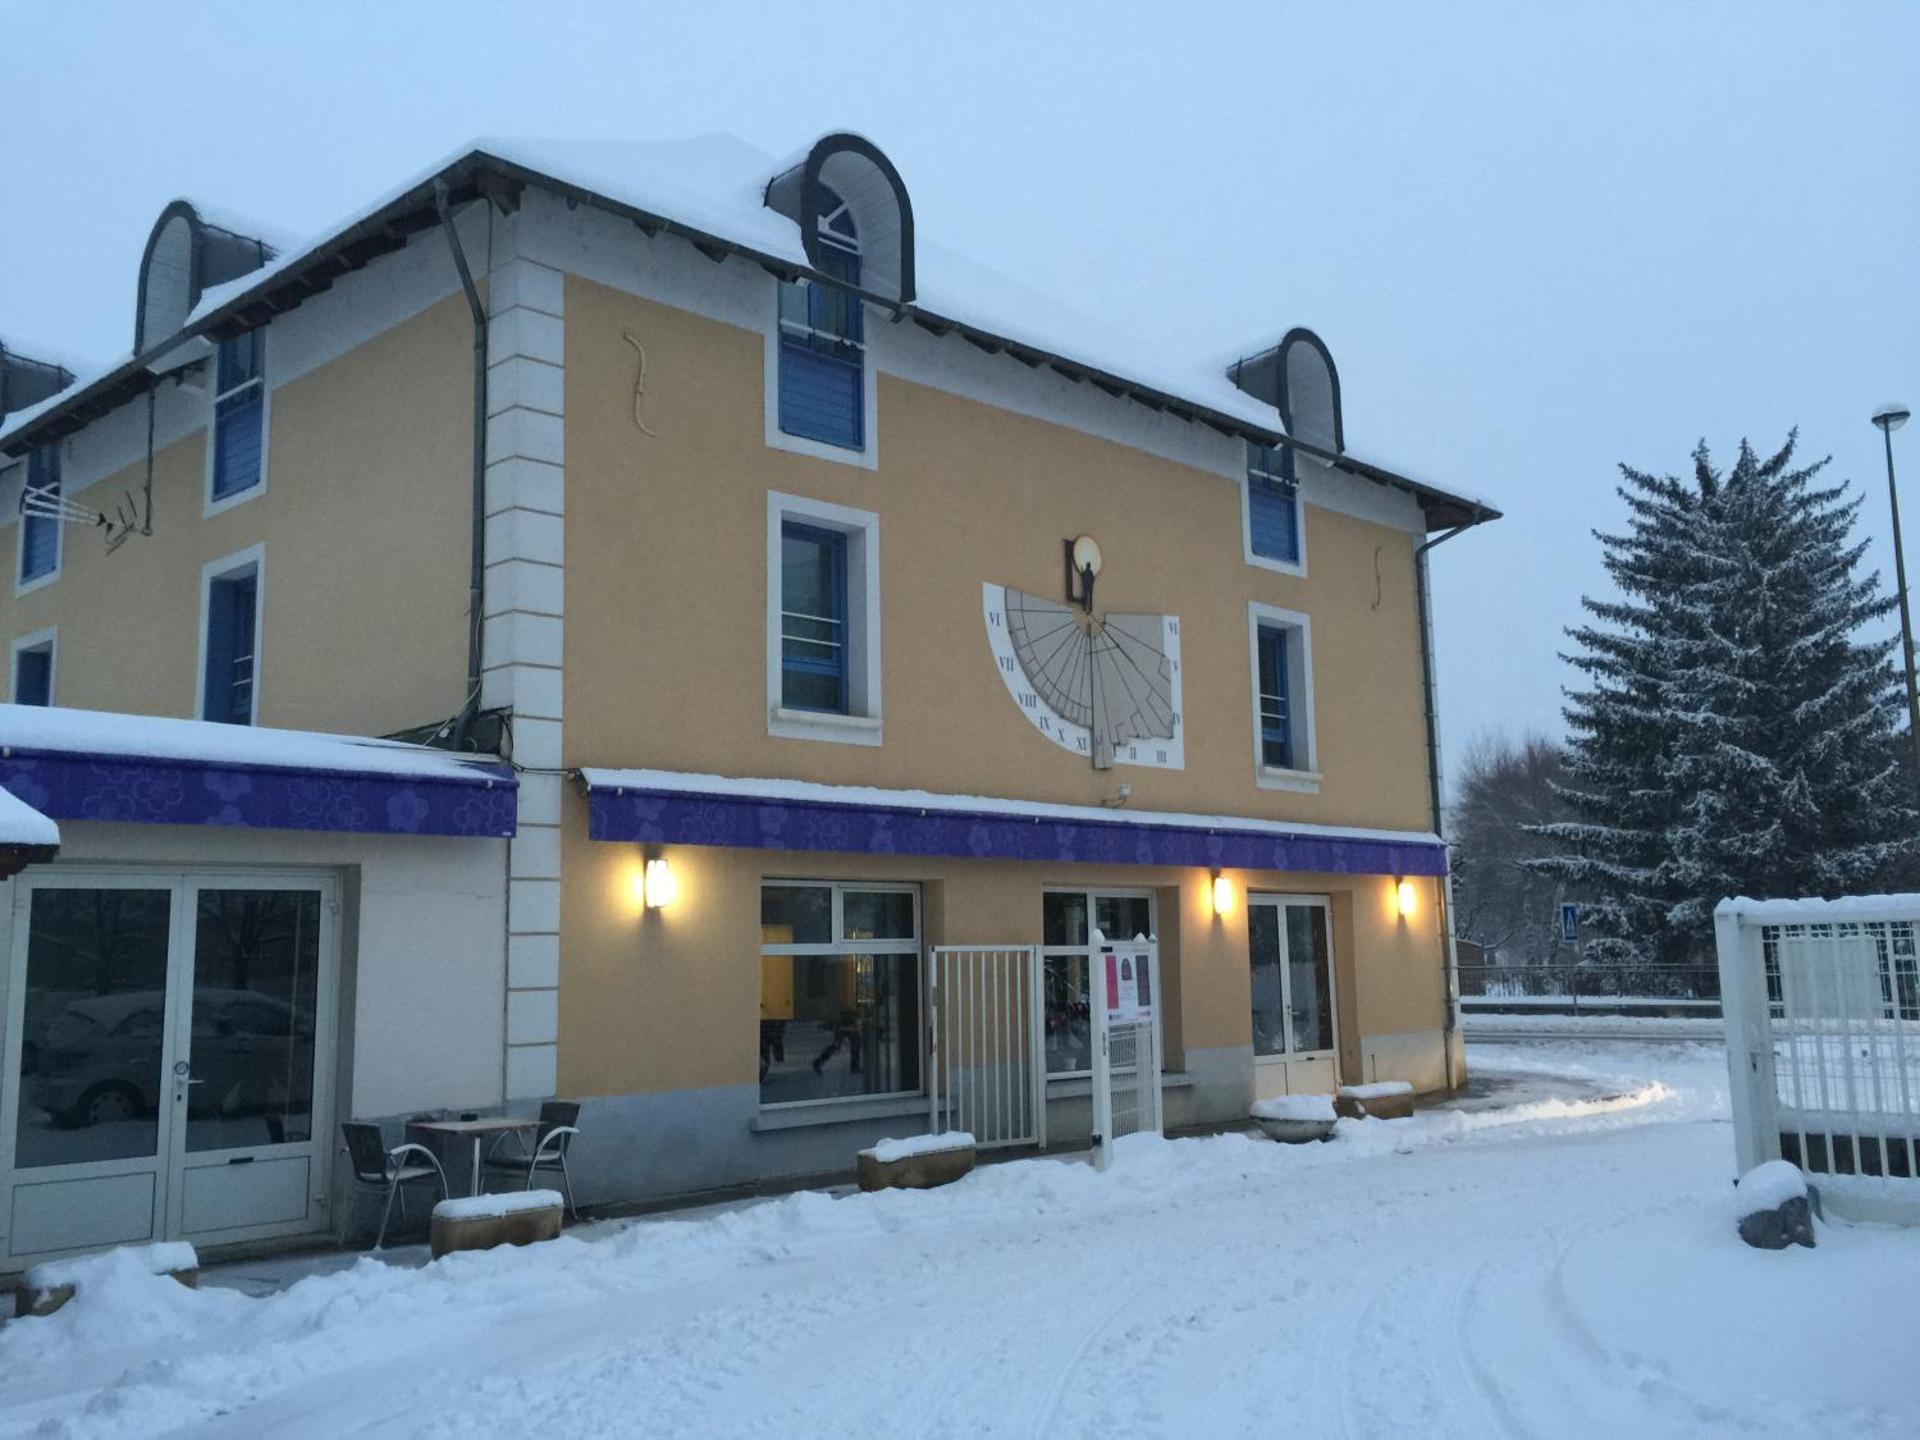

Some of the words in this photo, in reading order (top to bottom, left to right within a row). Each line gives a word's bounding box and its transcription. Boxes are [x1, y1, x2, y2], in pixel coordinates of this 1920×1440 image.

[989, 612, 1000, 626] VI
[1000, 656, 1014, 672] VII
[1018, 693, 1037, 708] VIII
[1040, 716, 1050, 730] IX
[1058, 728, 1066, 742] X
[1076, 737, 1087, 751] XI
[1156, 750, 1167, 763] III
